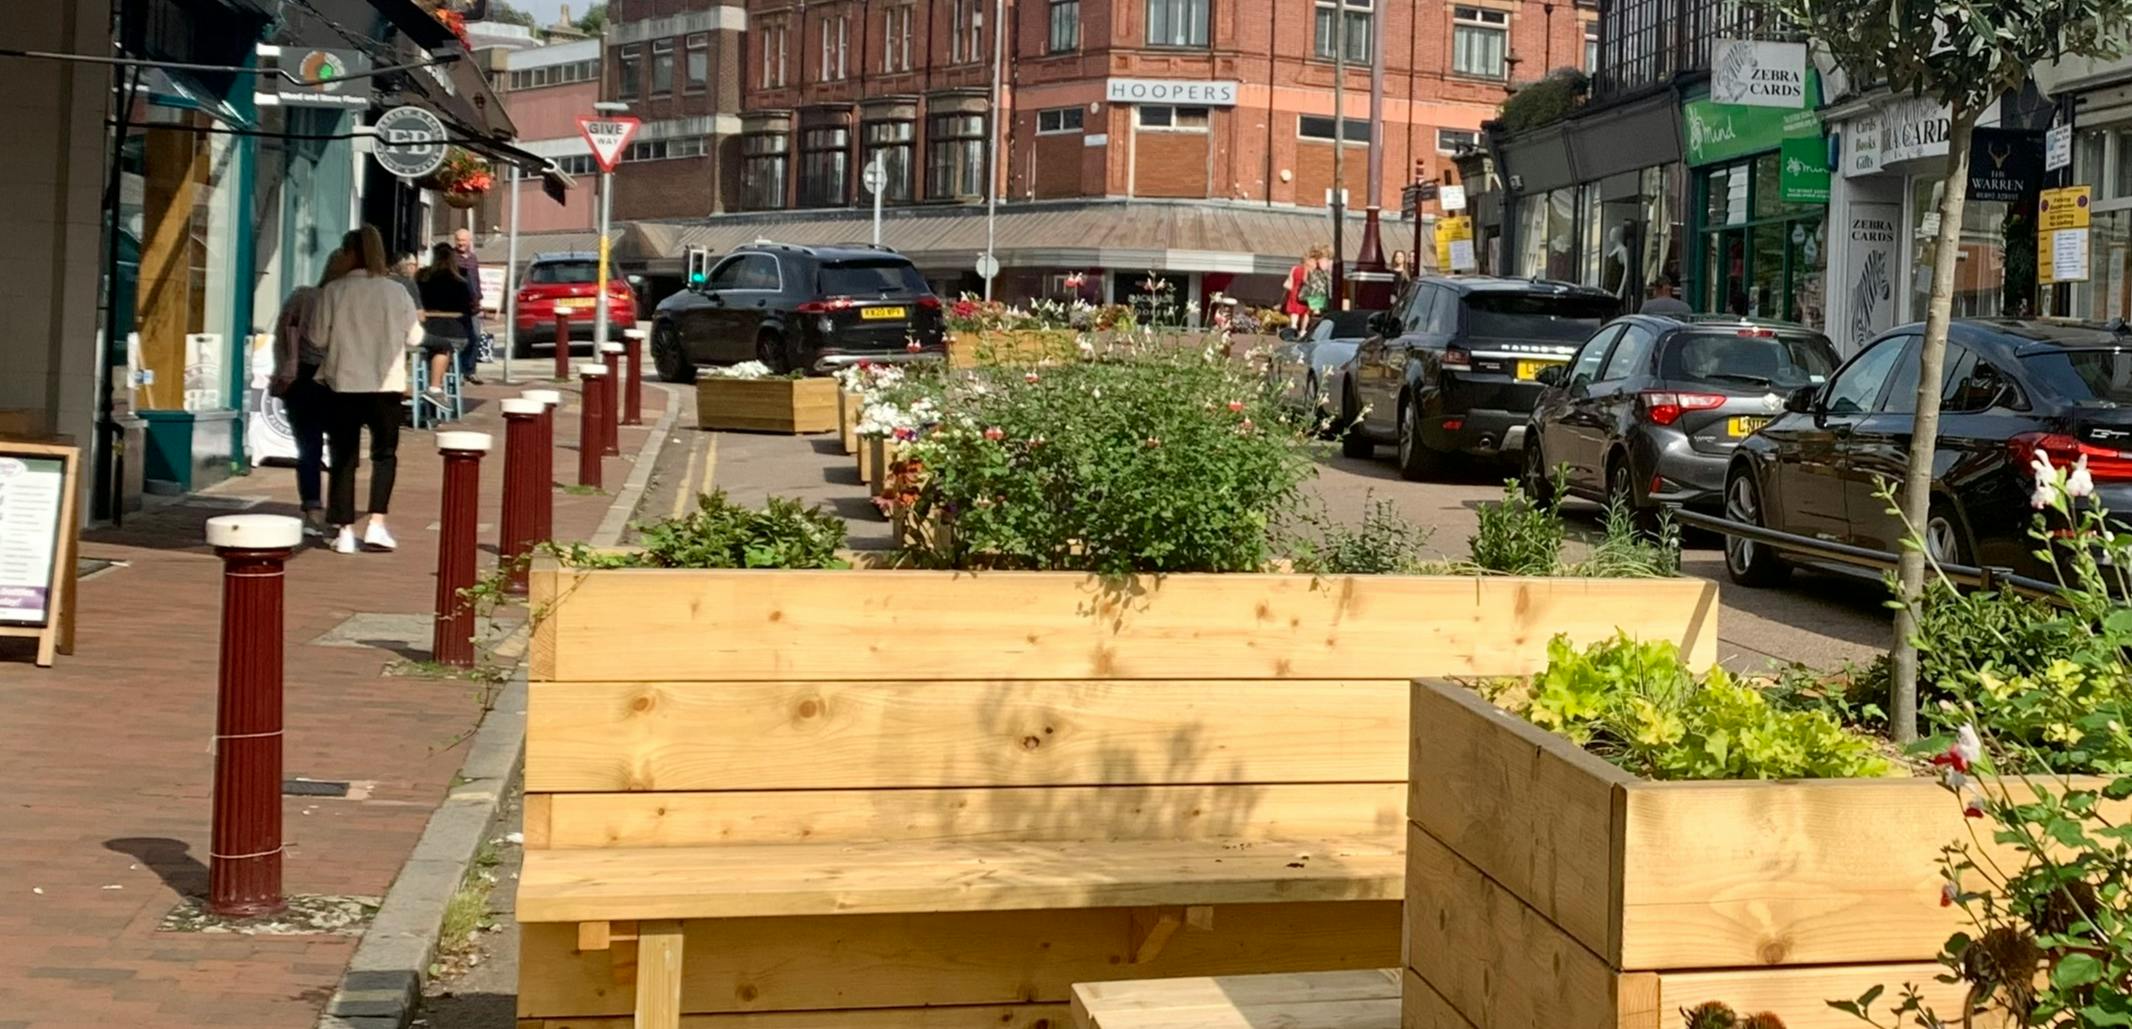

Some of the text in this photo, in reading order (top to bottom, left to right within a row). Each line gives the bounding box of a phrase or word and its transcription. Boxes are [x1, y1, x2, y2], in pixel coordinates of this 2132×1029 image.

[1751, 69, 1800, 83] ZEBRA
[1111, 82, 1232, 101] HOOPERS
[1750, 84, 1801, 97] CARDS
[588, 123, 623, 135] GIVE
[1902, 118, 1951, 148] CARD
[386, 129, 433, 155] FB
[597, 137, 618, 145] WAY
[1971, 178, 2024, 191] WARREN
[1853, 219, 1893, 231] ZEBRA
[1852, 231, 1894, 241] CARDS
